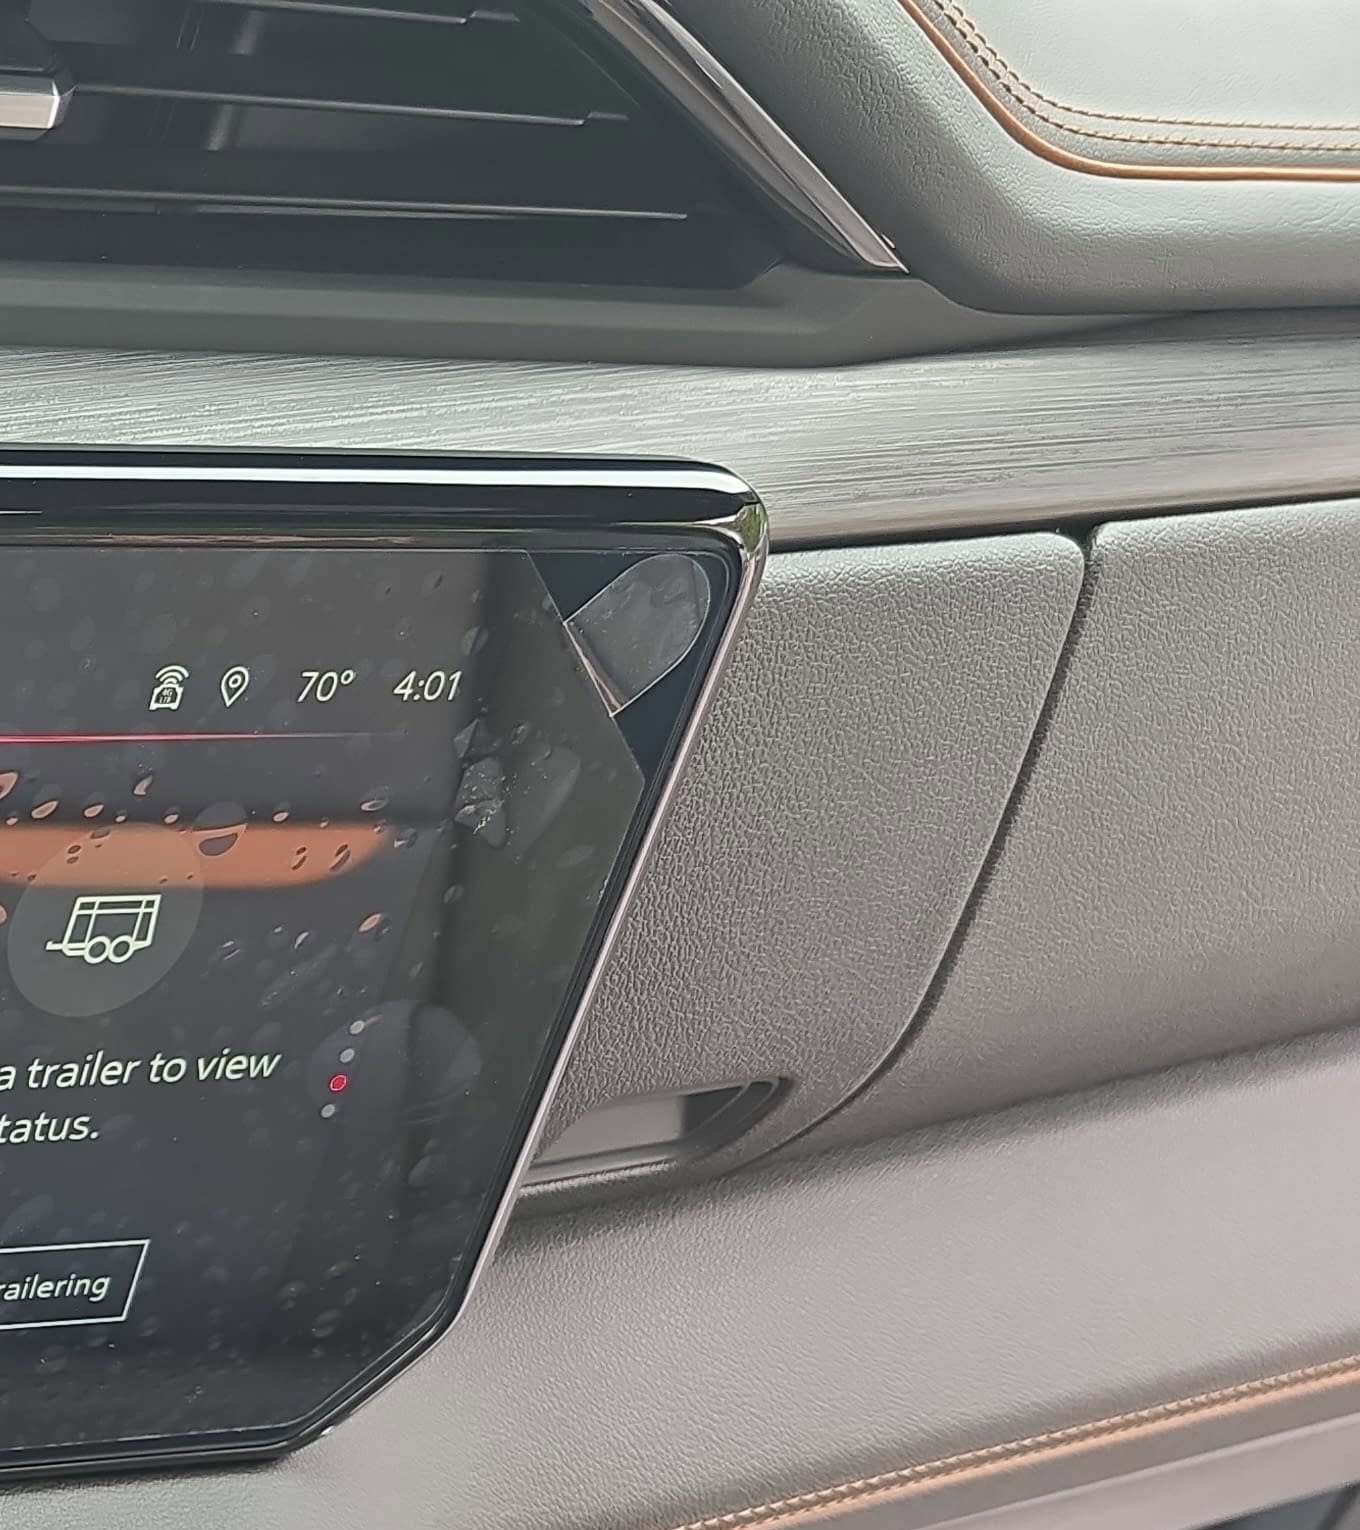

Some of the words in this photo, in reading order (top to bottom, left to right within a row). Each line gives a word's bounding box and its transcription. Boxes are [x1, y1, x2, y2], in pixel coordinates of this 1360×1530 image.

[297, 669, 356, 702] 70°
[393, 670, 462, 701] 4:01
[27, 1050, 142, 1088] trailer
[149, 1053, 187, 1083] to
[197, 1048, 282, 1081] view
